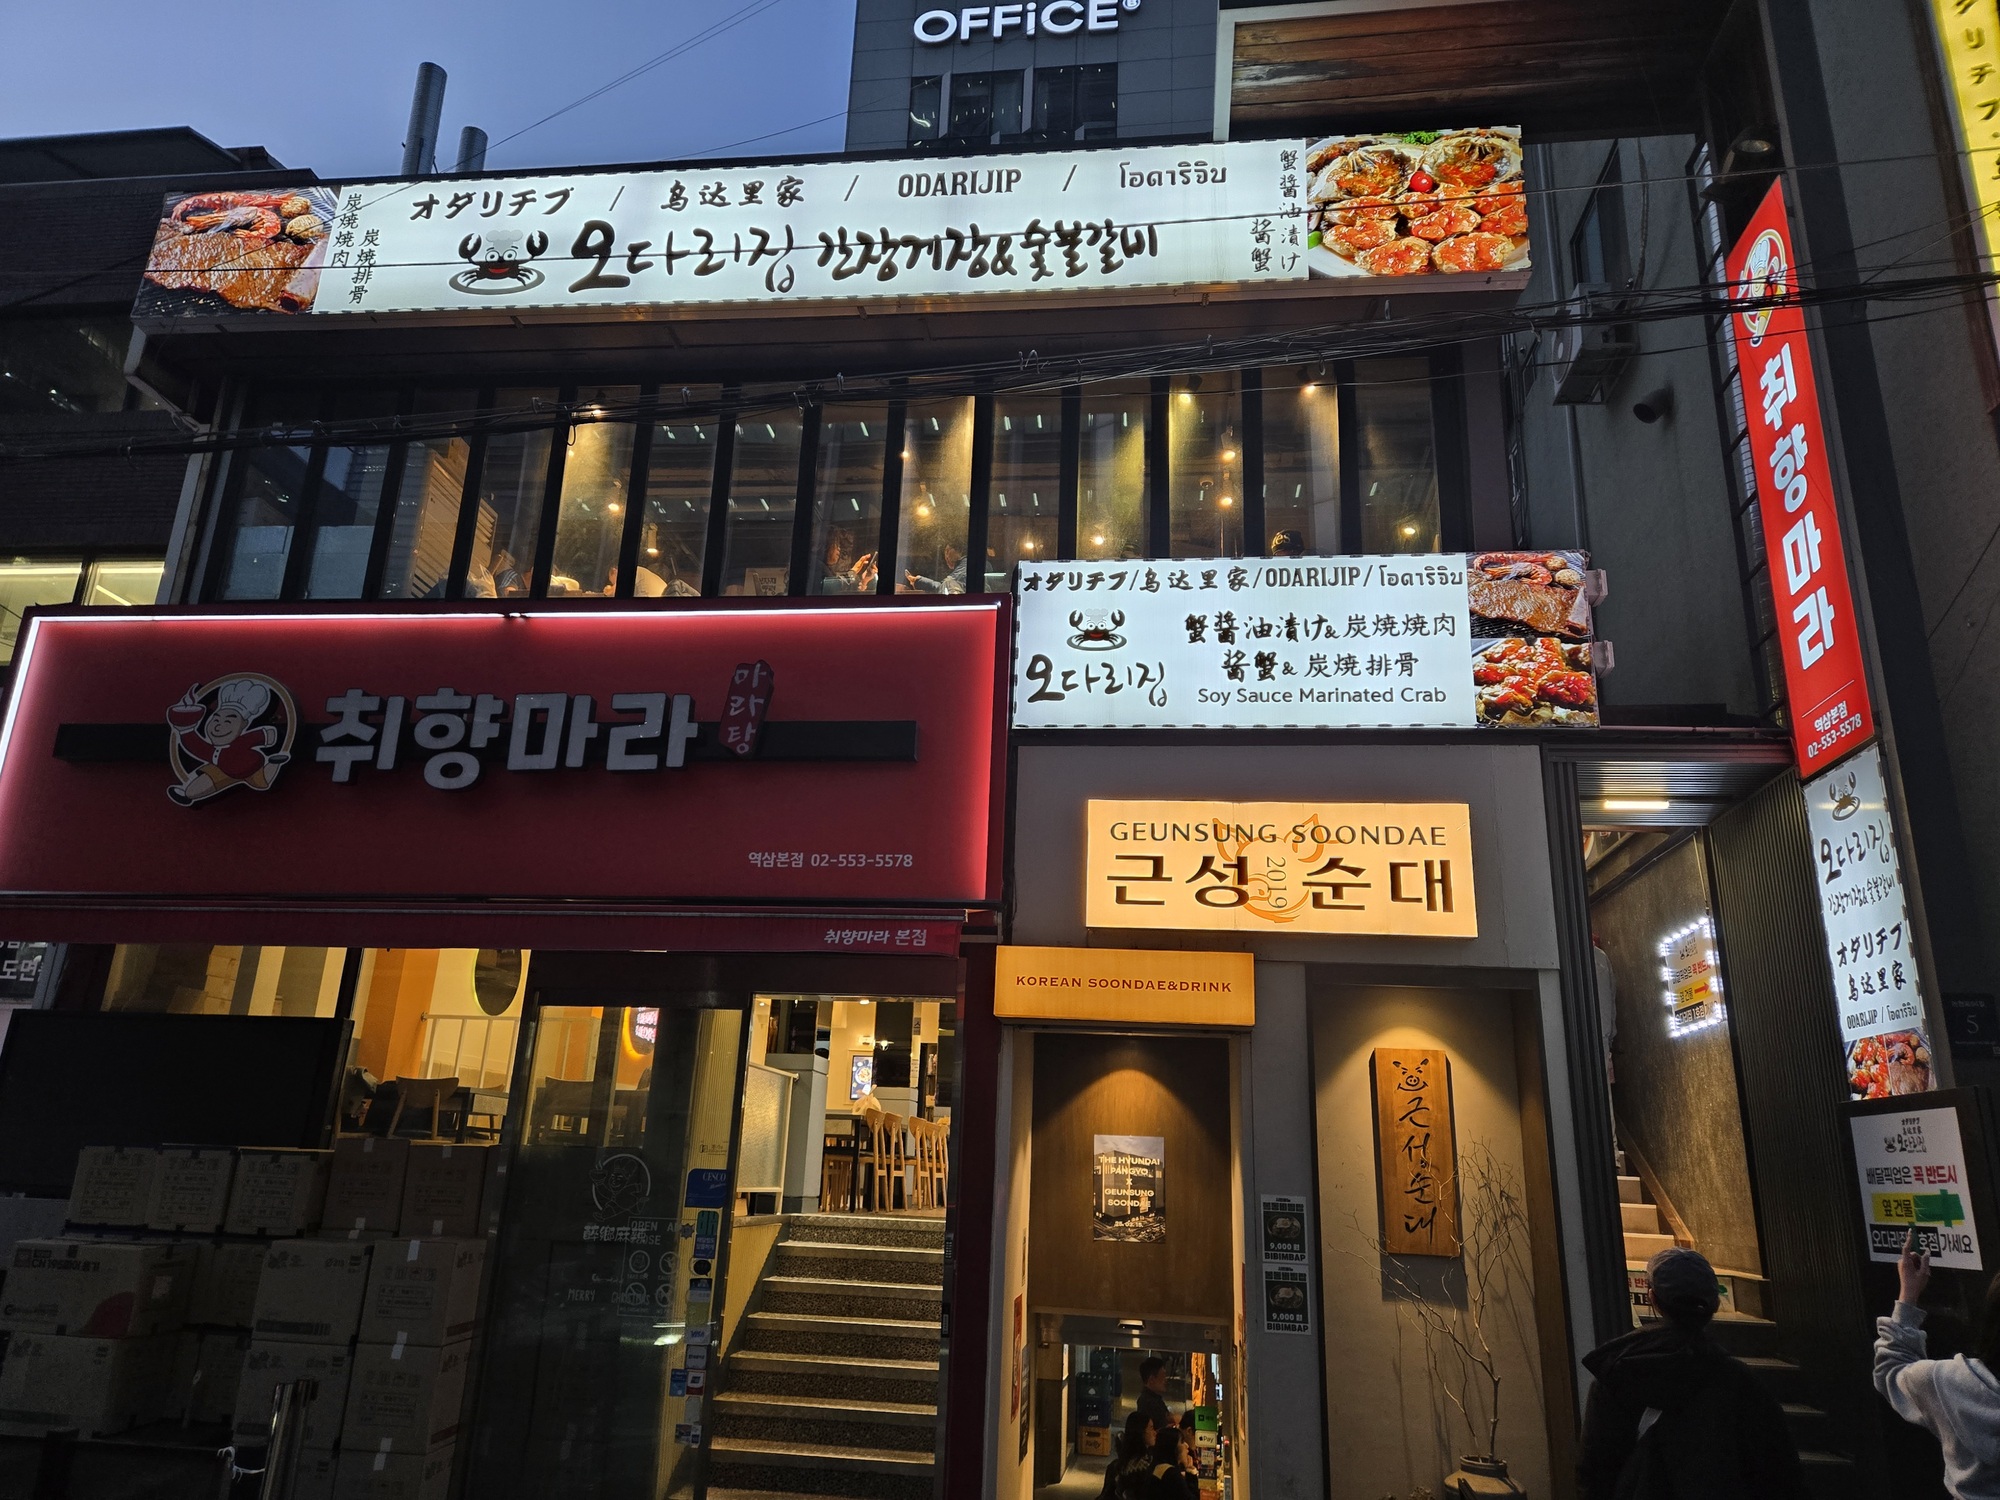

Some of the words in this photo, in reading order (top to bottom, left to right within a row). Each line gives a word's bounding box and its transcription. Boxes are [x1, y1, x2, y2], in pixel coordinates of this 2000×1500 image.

[410, 187, 574, 220] オダリチプ
[661, 176, 805, 213] 乌达里家
[898, 169, 1022, 198] ODARIJIP
[1119, 163, 1227, 190] โอดาริจิบ
[568, 220, 795, 294] 오다리집
[1761, 342, 1837, 671] 취향마라
[1025, 655, 1168, 706] 오다리집
[1198, 687, 1233, 706] Soy
[1237, 687, 1294, 703] Sauce
[1299, 686, 1395, 703] Marinated
[1400, 687, 1447, 703] Crab
[731, 663, 768, 754] 마라탕
[1813, 700, 1849, 733] 역삼본점
[315, 685, 700, 789] 취향마라
[1807, 713, 1863, 759] 02-553-5578
[1110, 822, 1276, 844] GEUNSUNG
[1291, 824, 1447, 847] SOONDAE
[748, 852, 804, 868] 역삼본점
[810, 853, 913, 868] 02-553-5578
[1819, 818, 1891, 884] 오다리집
[1266, 855, 1288, 910] 2019
[824, 929, 890, 945] 취향마라
[895, 929, 928, 946] 본점
[1837, 922, 1903, 966] オダリチプ
[1016, 975, 1082, 988] KOREAN
[1088, 977, 1232, 993] SOONDAE&DRINK
[1846, 1009, 1879, 1031] ODARIJIP
[1098, 1156, 1117, 1164] THE
[1119, 1156, 1160, 1166] HYUNDAI
[1110, 1167, 1148, 1175] PANGYO
[1398, 1095, 1435, 1245] 근성순대
[702, 1171, 727, 1182] CESCO
[1866, 1165, 1912, 1185] 배달픽업은
[1913, 1165, 1925, 1185] 꼭
[1925, 1165, 1958, 1184] 반드시
[1104, 1188, 1155, 1197] GEUNSUNG
[1107, 1199, 1151, 1208] SOONDAE
[1882, 1199, 1893, 1217] 옆
[1894, 1199, 1913, 1217] 건물
[1270, 1242, 1292, 1250] 9,000
[1940, 1233, 1974, 1254] 가세요
[1264, 1252, 1306, 1262] BIBIMBAP
[1272, 1313, 1294, 1321] 9,000
[1266, 1322, 1309, 1333] BIBIMBAP
[1203, 1436, 1214, 1444] Pay
